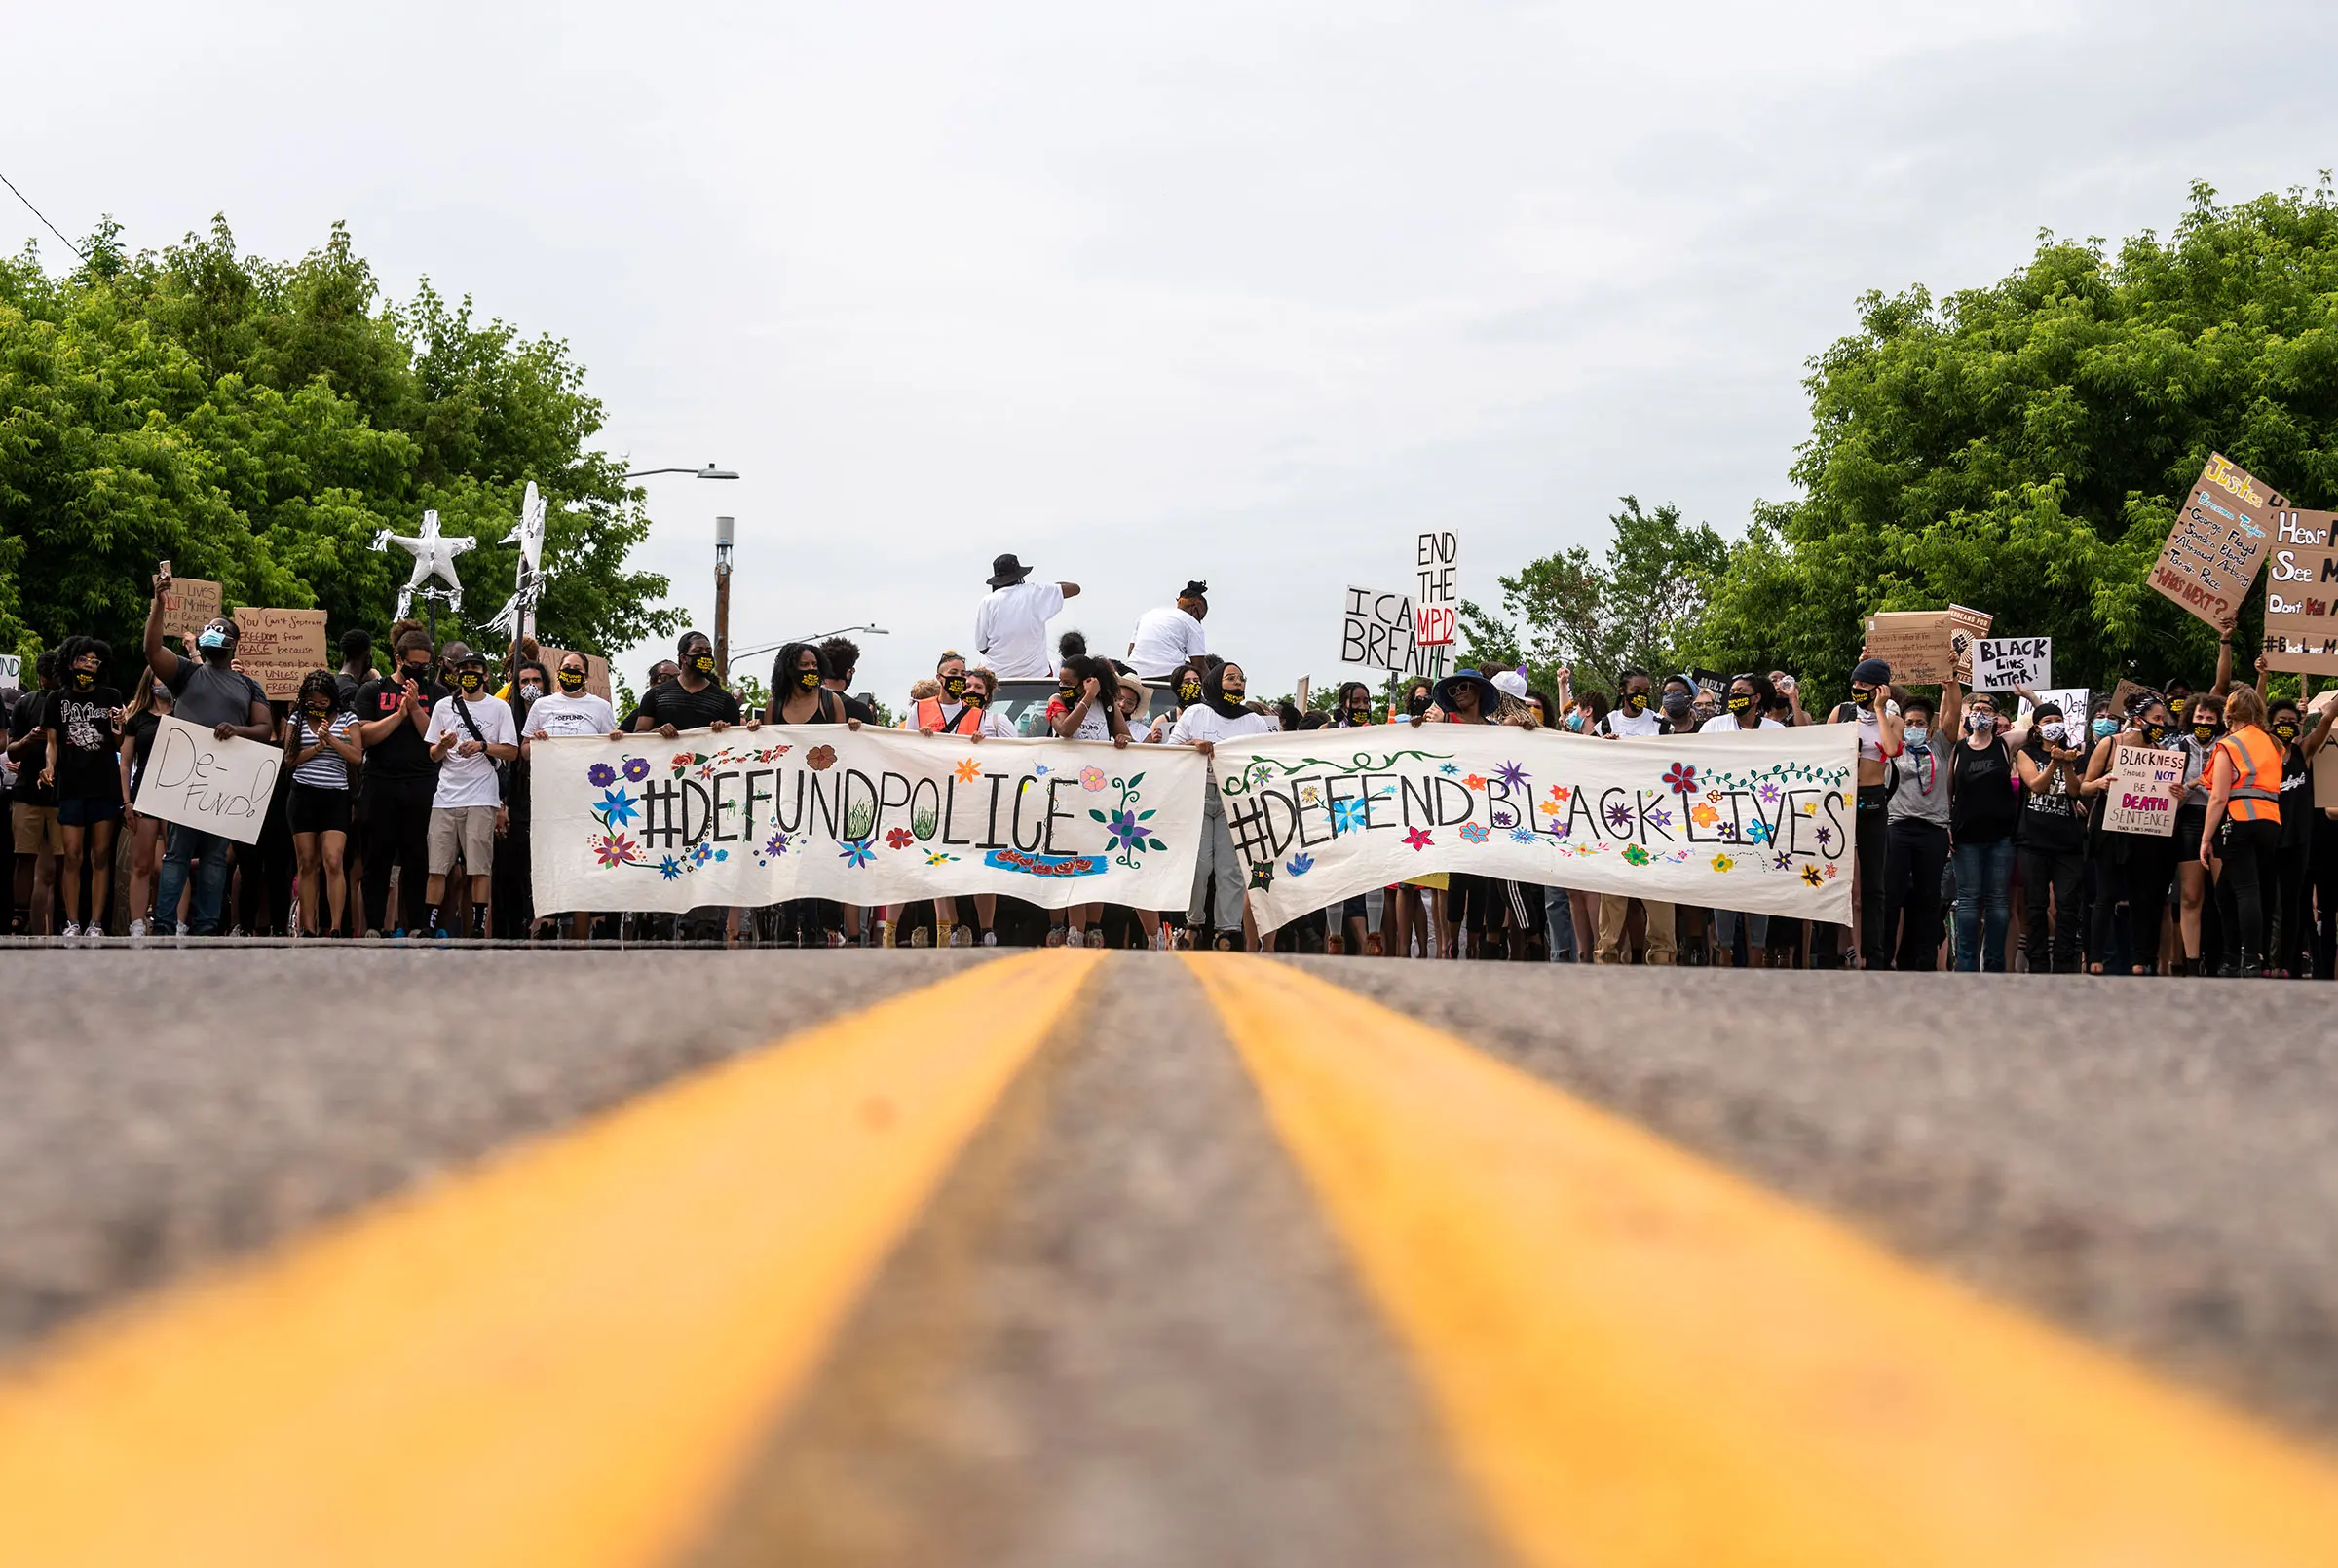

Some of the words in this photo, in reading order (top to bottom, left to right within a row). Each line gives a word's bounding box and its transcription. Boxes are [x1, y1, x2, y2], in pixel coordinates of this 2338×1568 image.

[2204, 454, 2263, 508] Justice
[2239, 514, 2265, 538] Taylor
[2277, 511, 2326, 545] Hear
[1418, 532, 1456, 566] END
[2219, 543, 2246, 566] Bland
[2227, 529, 2258, 558] Floyd
[2216, 559, 2250, 587] Arbery
[2271, 550, 2313, 582] See
[1417, 567, 1456, 603] THE
[2199, 567, 2221, 591] Rice
[1346, 587, 1370, 617] I
[1375, 594, 1416, 631] CA
[1950, 610, 1976, 623] KOREANS
[1977, 617, 1989, 627] FOR
[239, 613, 259, 629] You
[1417, 608, 1454, 645] MPD
[283, 632, 303, 642] from
[238, 644, 270, 654] PEACE
[278, 646, 314, 654] because
[1980, 639, 2048, 663] BLACK
[265, 669, 299, 679] UNLESS
[297, 659, 309, 668] be
[1996, 658, 2024, 670] Lives
[558, 674, 582, 684] POLICE
[1698, 677, 1726, 692] MELT
[2065, 692, 2087, 718] Dept
[1969, 759, 1995, 772] NIKE
[2120, 748, 2184, 770] BLACKNESS
[2122, 768, 2146, 778] SHOULD
[2154, 770, 2176, 781] NOT
[184, 759, 277, 818] FUND!
[2133, 783, 2146, 792] BE
[2150, 784, 2157, 793] A
[2122, 793, 2168, 811] DEATH
[2109, 808, 2170, 828] SENTENCE
